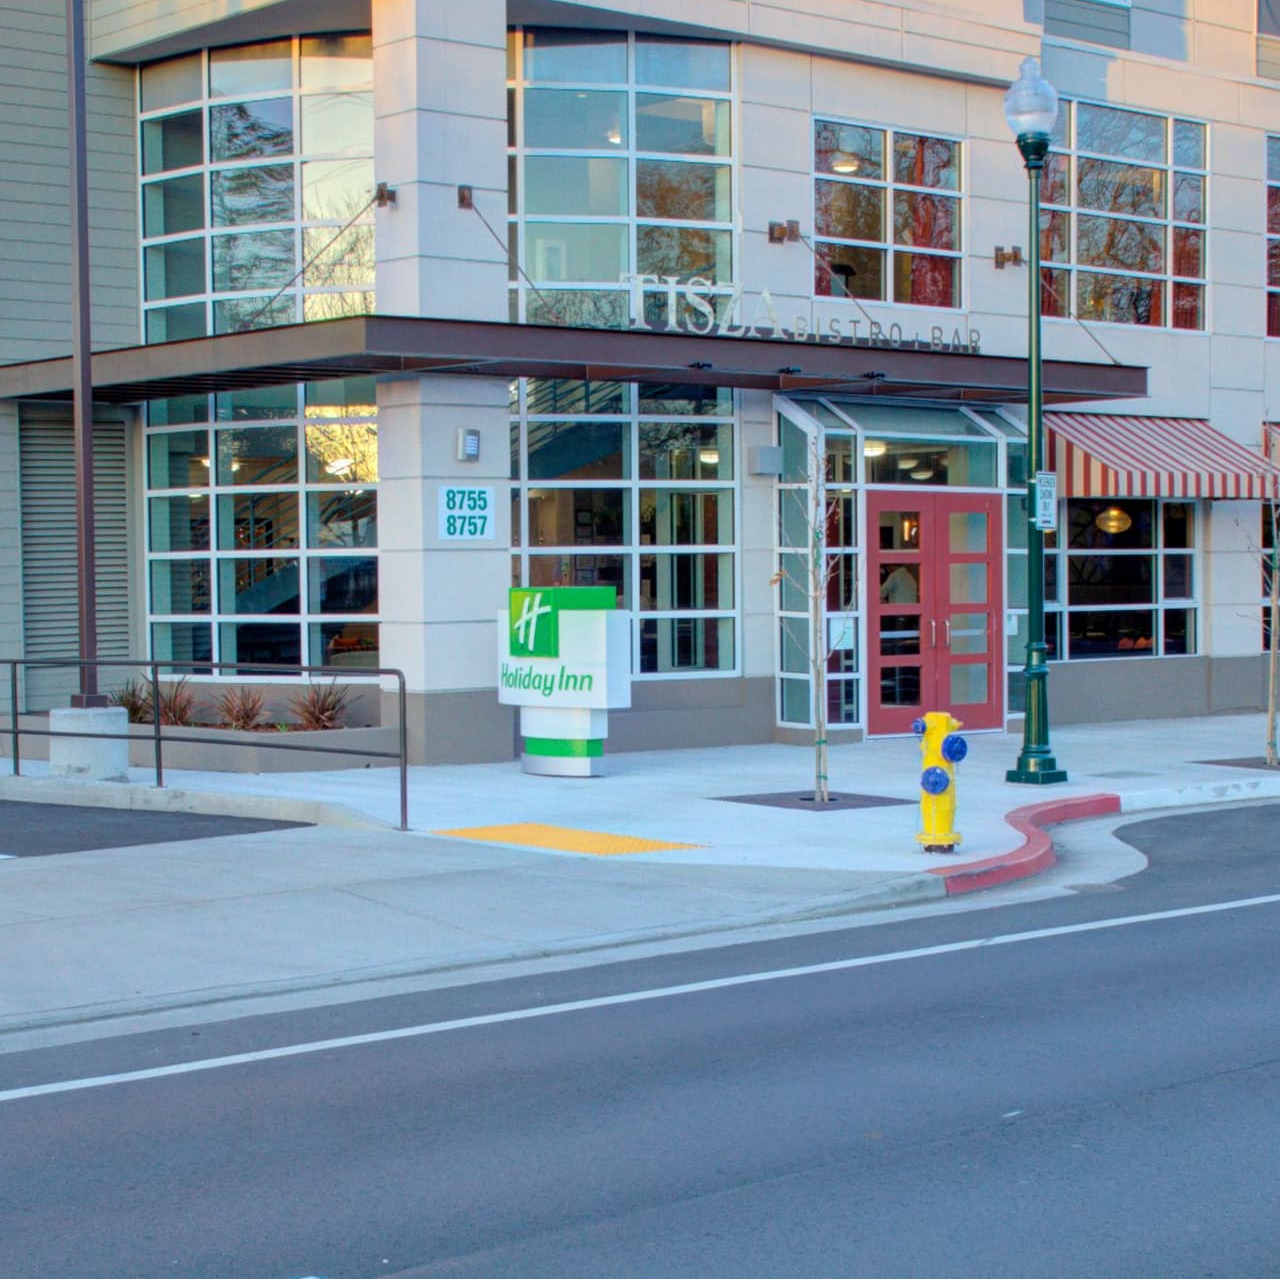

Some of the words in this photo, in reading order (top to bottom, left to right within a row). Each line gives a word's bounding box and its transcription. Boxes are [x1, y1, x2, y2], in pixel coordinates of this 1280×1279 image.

[619, 272, 788, 339] TISZA
[794, 315, 902, 349] BISTRO
[930, 325, 982, 355] BAR
[446, 488, 488, 511] 8755
[446, 514, 488, 536] 8757
[501, 662, 555, 698] Holiday
[558, 665, 593, 691] Inn
